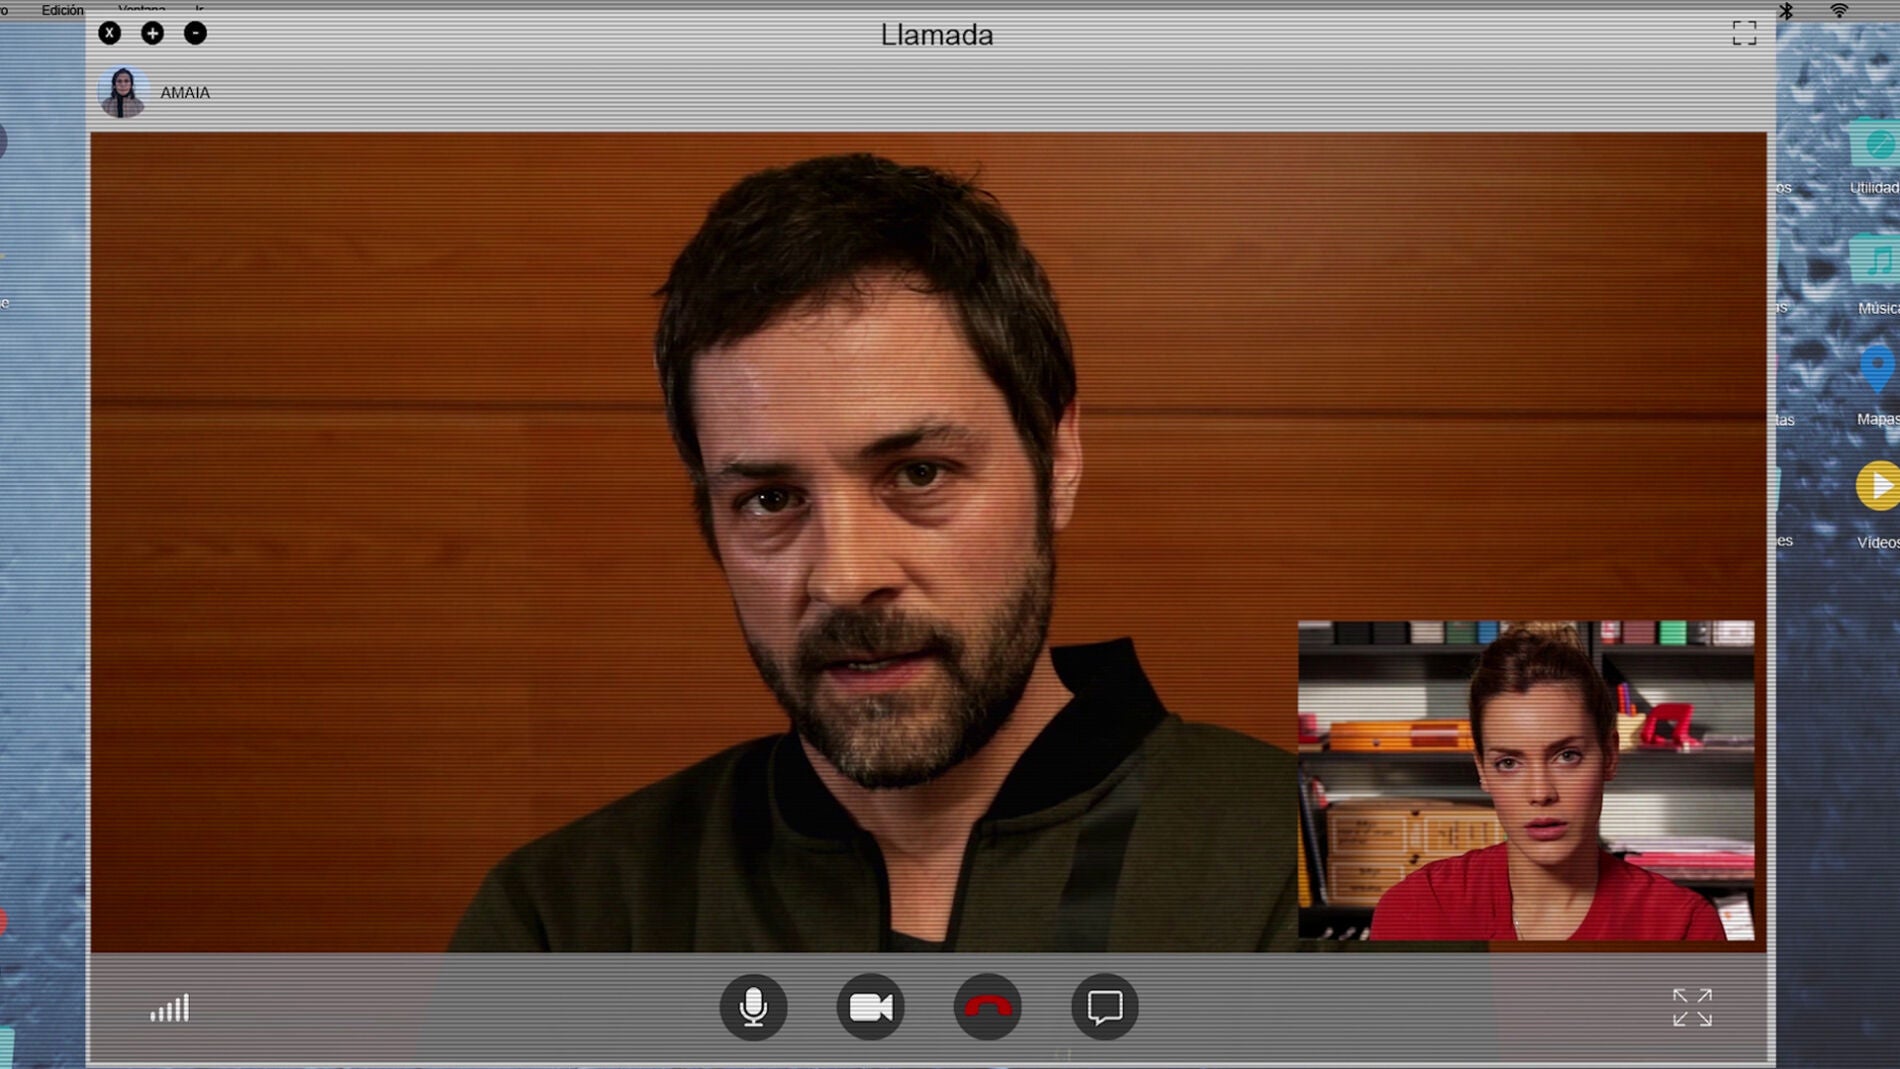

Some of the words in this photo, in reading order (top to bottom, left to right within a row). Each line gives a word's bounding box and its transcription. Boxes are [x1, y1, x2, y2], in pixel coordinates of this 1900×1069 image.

[42, 3, 84, 16] Edición
[882, 22, 993, 46] Llamada
[160, 86, 211, 99] AMAIA
[1850, 180, 1900, 194] Utilidad
